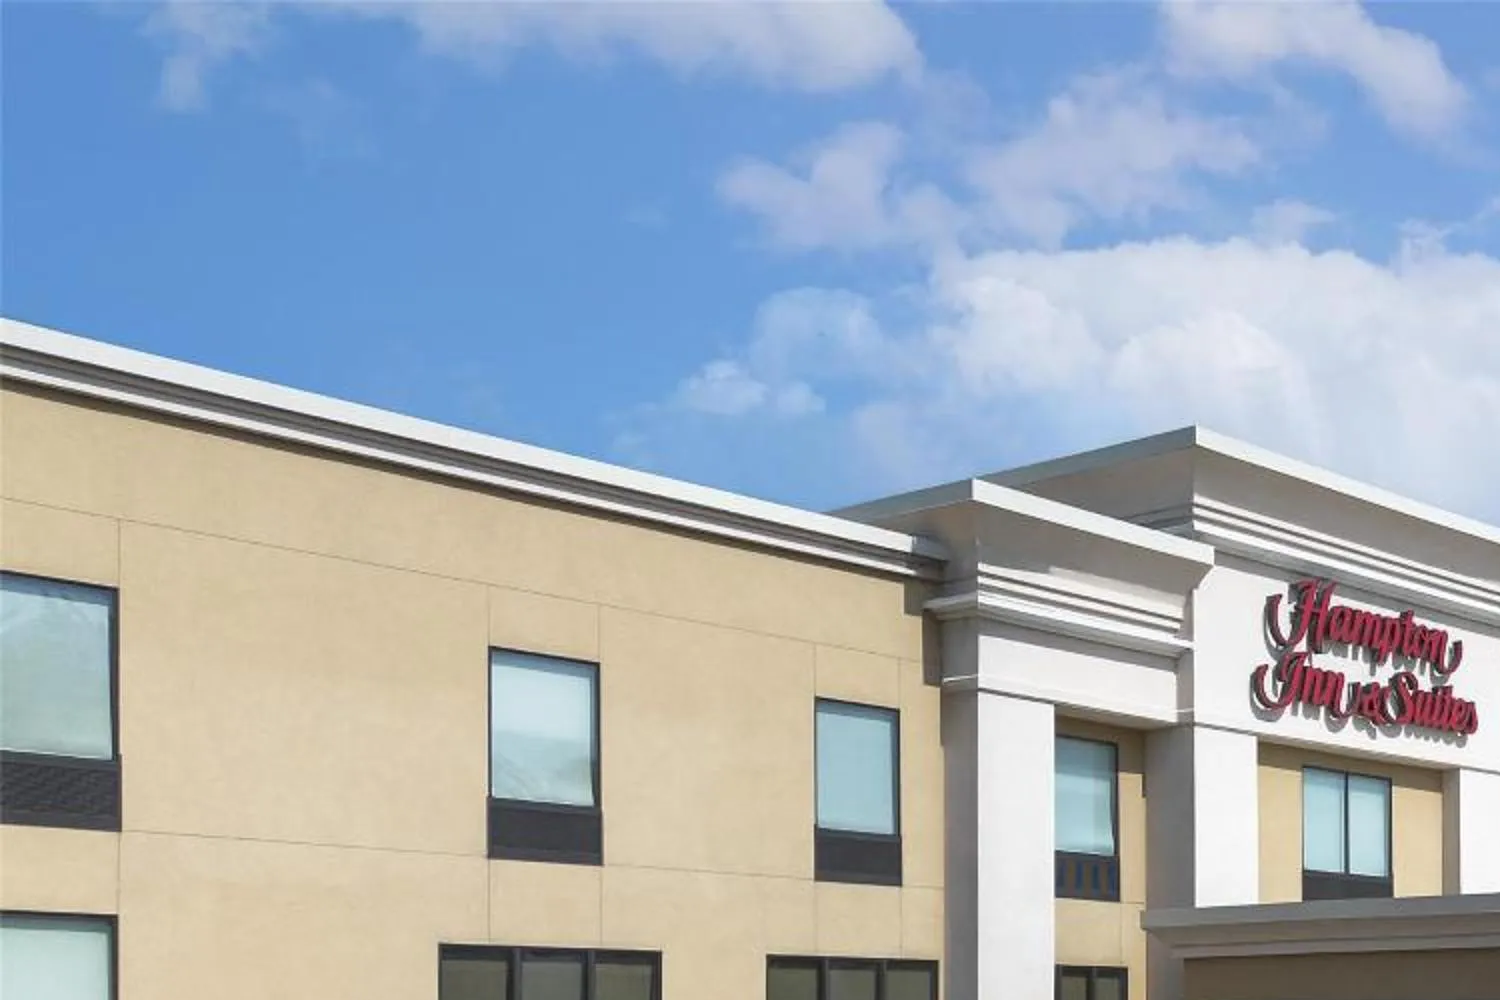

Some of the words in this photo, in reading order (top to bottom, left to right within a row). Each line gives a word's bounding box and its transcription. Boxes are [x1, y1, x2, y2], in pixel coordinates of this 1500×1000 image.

[1264, 577, 1462, 674] Hampton
[1251, 651, 1348, 719] Inn
[1380, 671, 1478, 735] Suites
